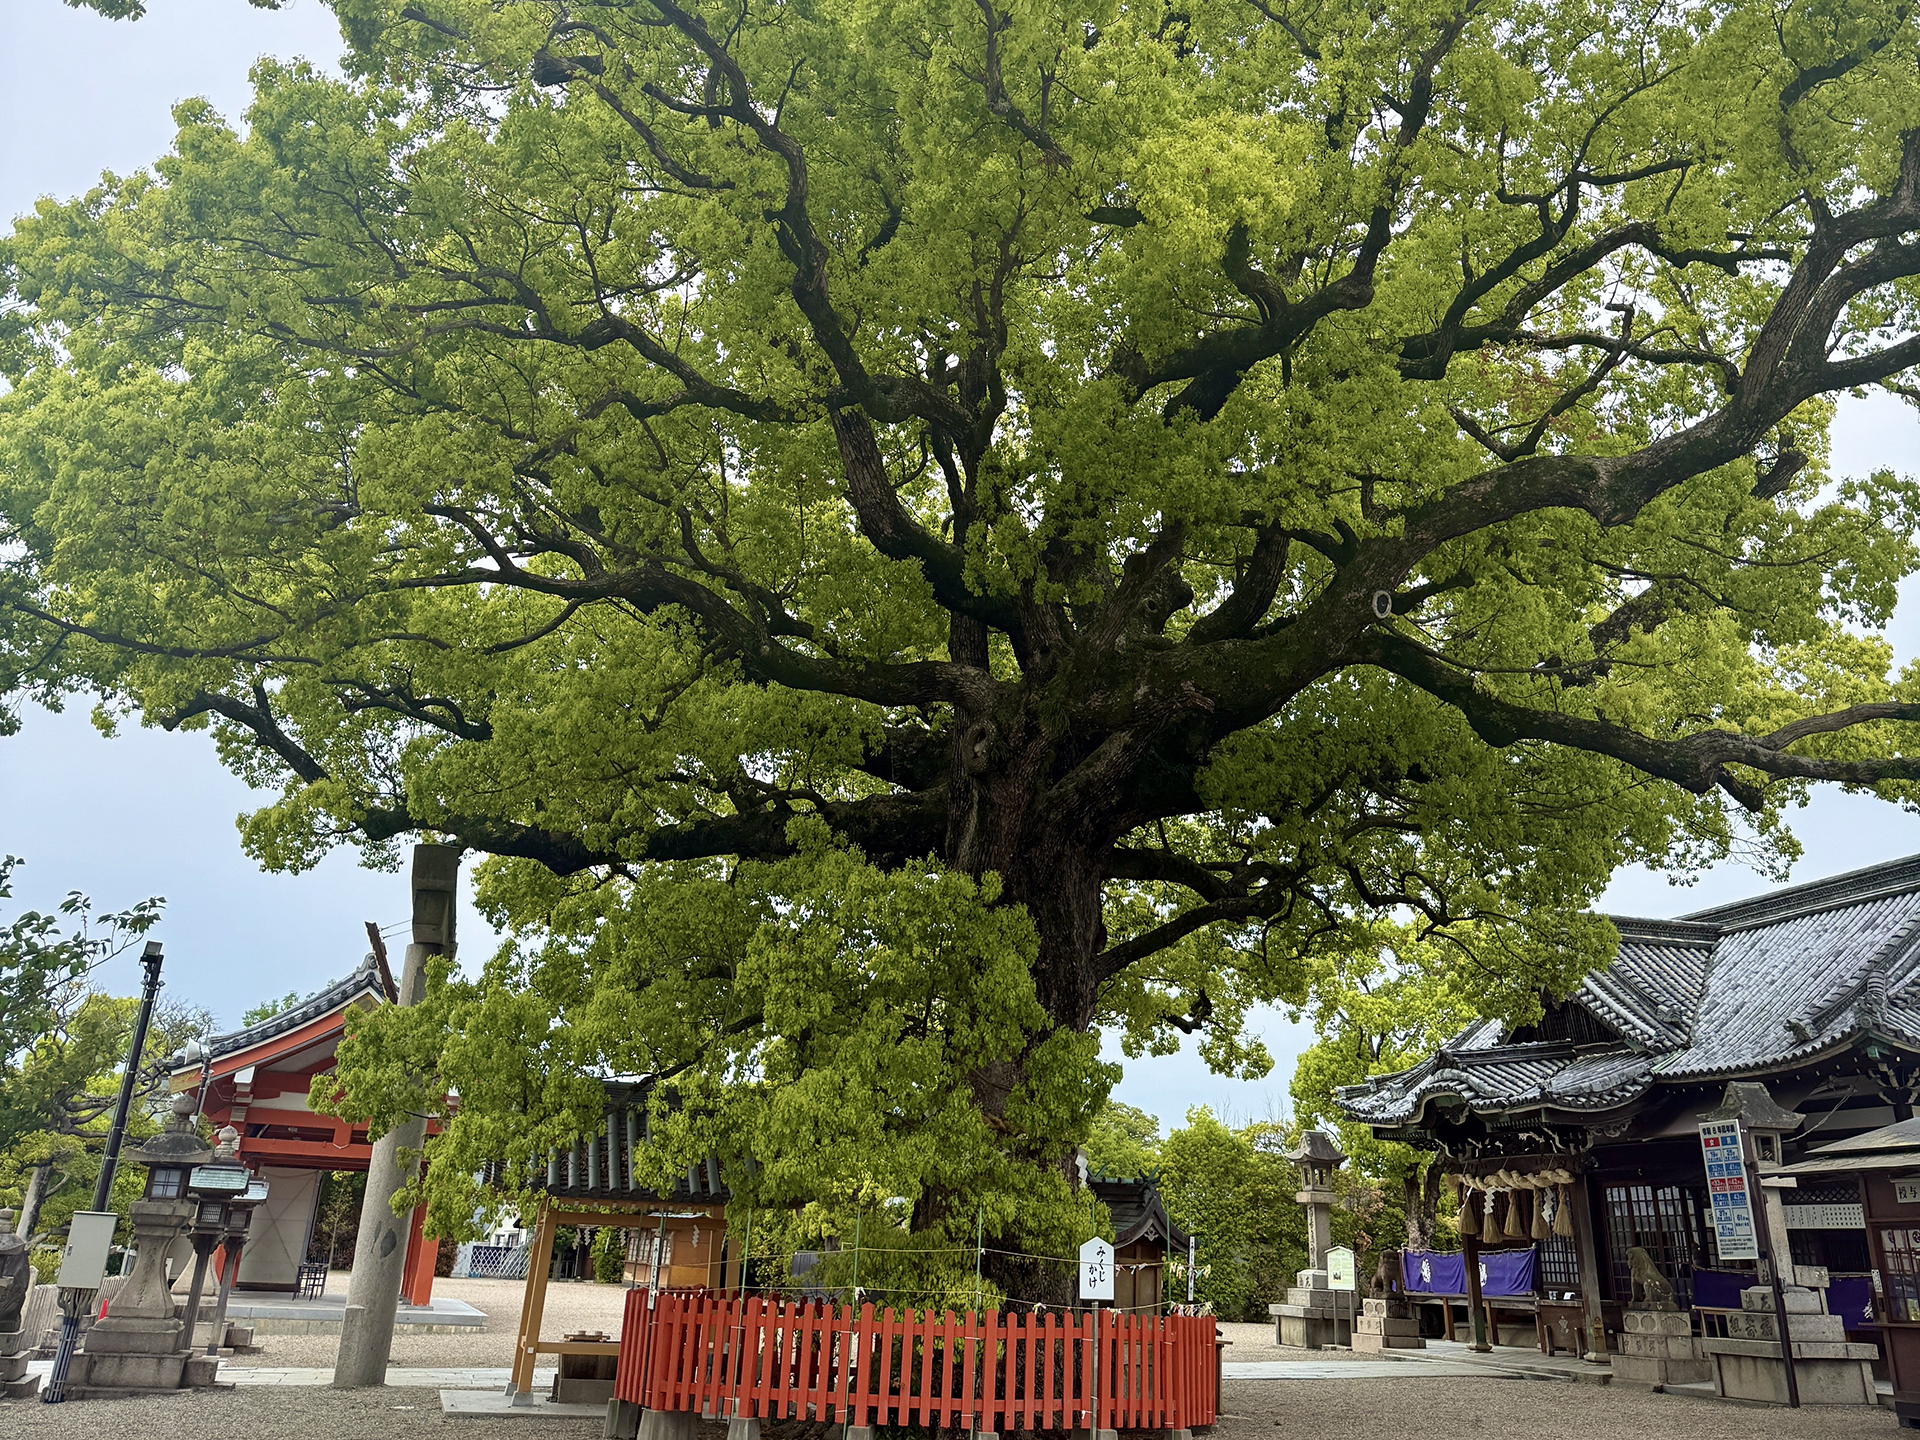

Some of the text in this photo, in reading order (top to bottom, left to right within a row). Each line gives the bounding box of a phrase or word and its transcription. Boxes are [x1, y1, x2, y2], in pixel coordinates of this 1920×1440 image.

[1898, 1186, 1917, 1199] 授与
[1088, 1264, 1097, 1290] かけ
[1096, 1246, 1106, 1282] みくじ
